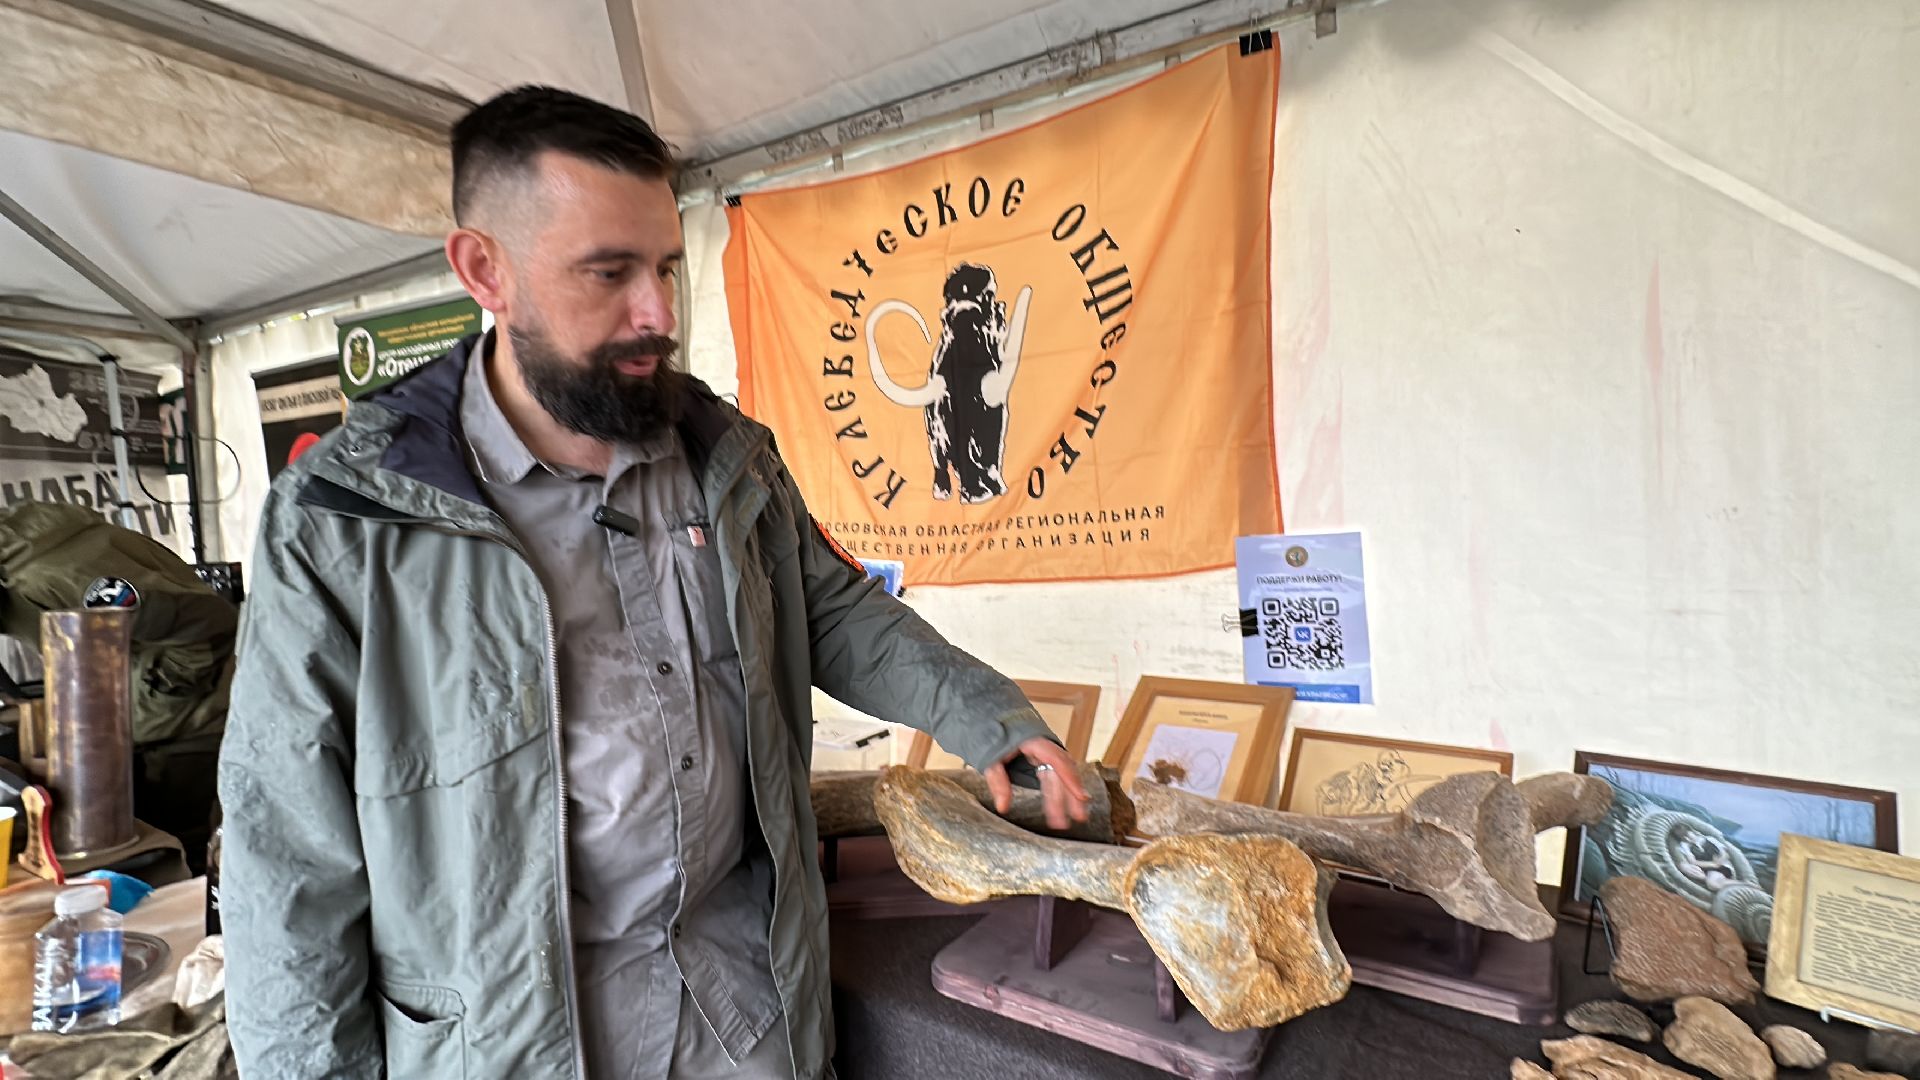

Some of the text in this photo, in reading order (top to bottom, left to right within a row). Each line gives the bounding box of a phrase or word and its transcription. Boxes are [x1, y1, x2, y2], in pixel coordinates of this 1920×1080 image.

[1027, 203, 1133, 499] ОБЩЕСТВО
[825, 505, 1165, 537] ОСКОВСКАЯ ОБЛАСТНАЯ РЕГИОНАЛЬНАЯ
[838, 528, 1150, 556] ЩЕСТВЕННАЯ ОРГАНИЗАЦИЯ
